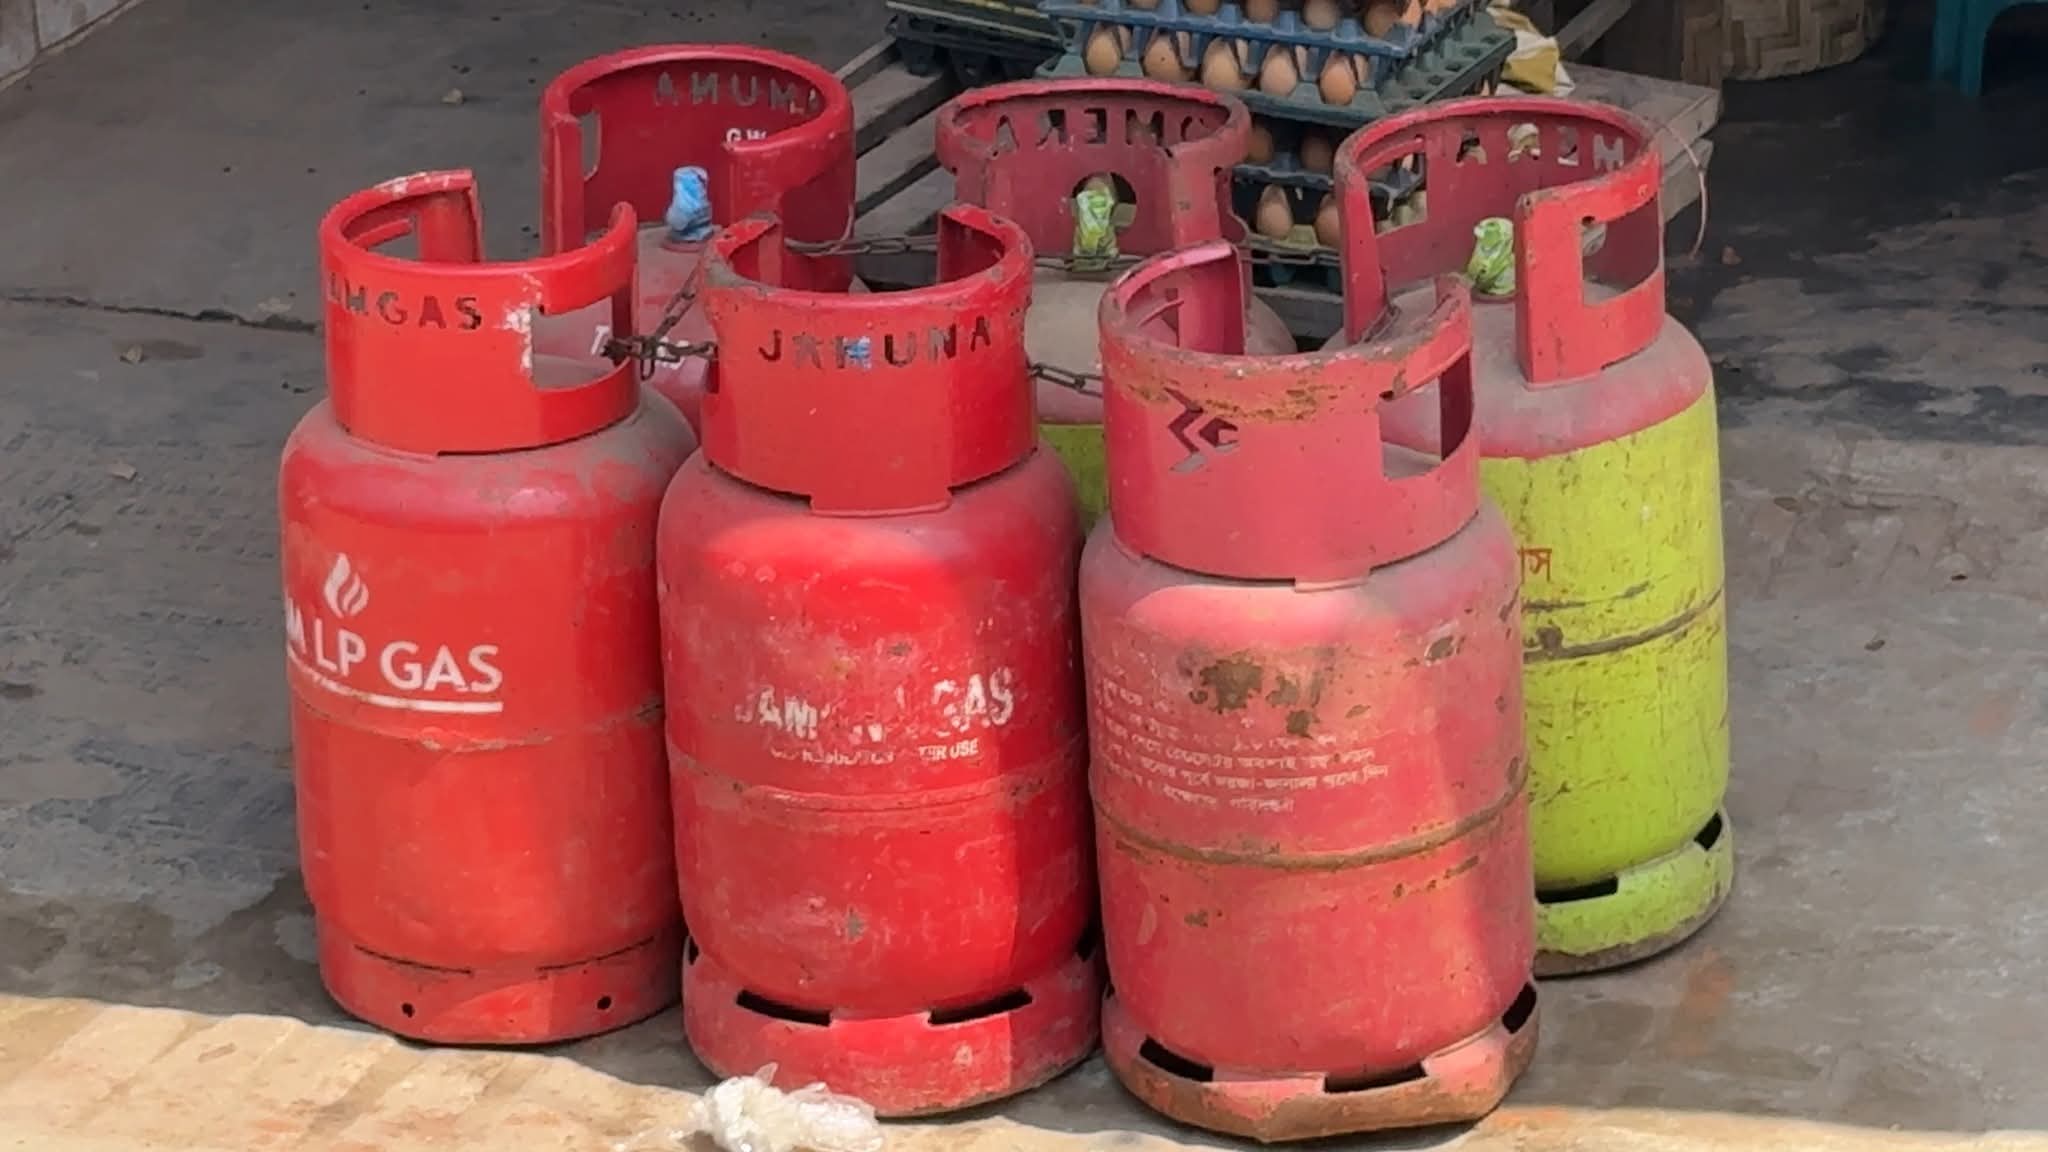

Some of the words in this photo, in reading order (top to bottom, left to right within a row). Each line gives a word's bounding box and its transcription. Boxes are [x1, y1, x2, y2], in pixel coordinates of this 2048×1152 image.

[758, 315, 991, 369] JAMUNA
[314, 617, 367, 678] LP
[380, 640, 503, 693] GAS
[949, 738, 979, 760] USE
